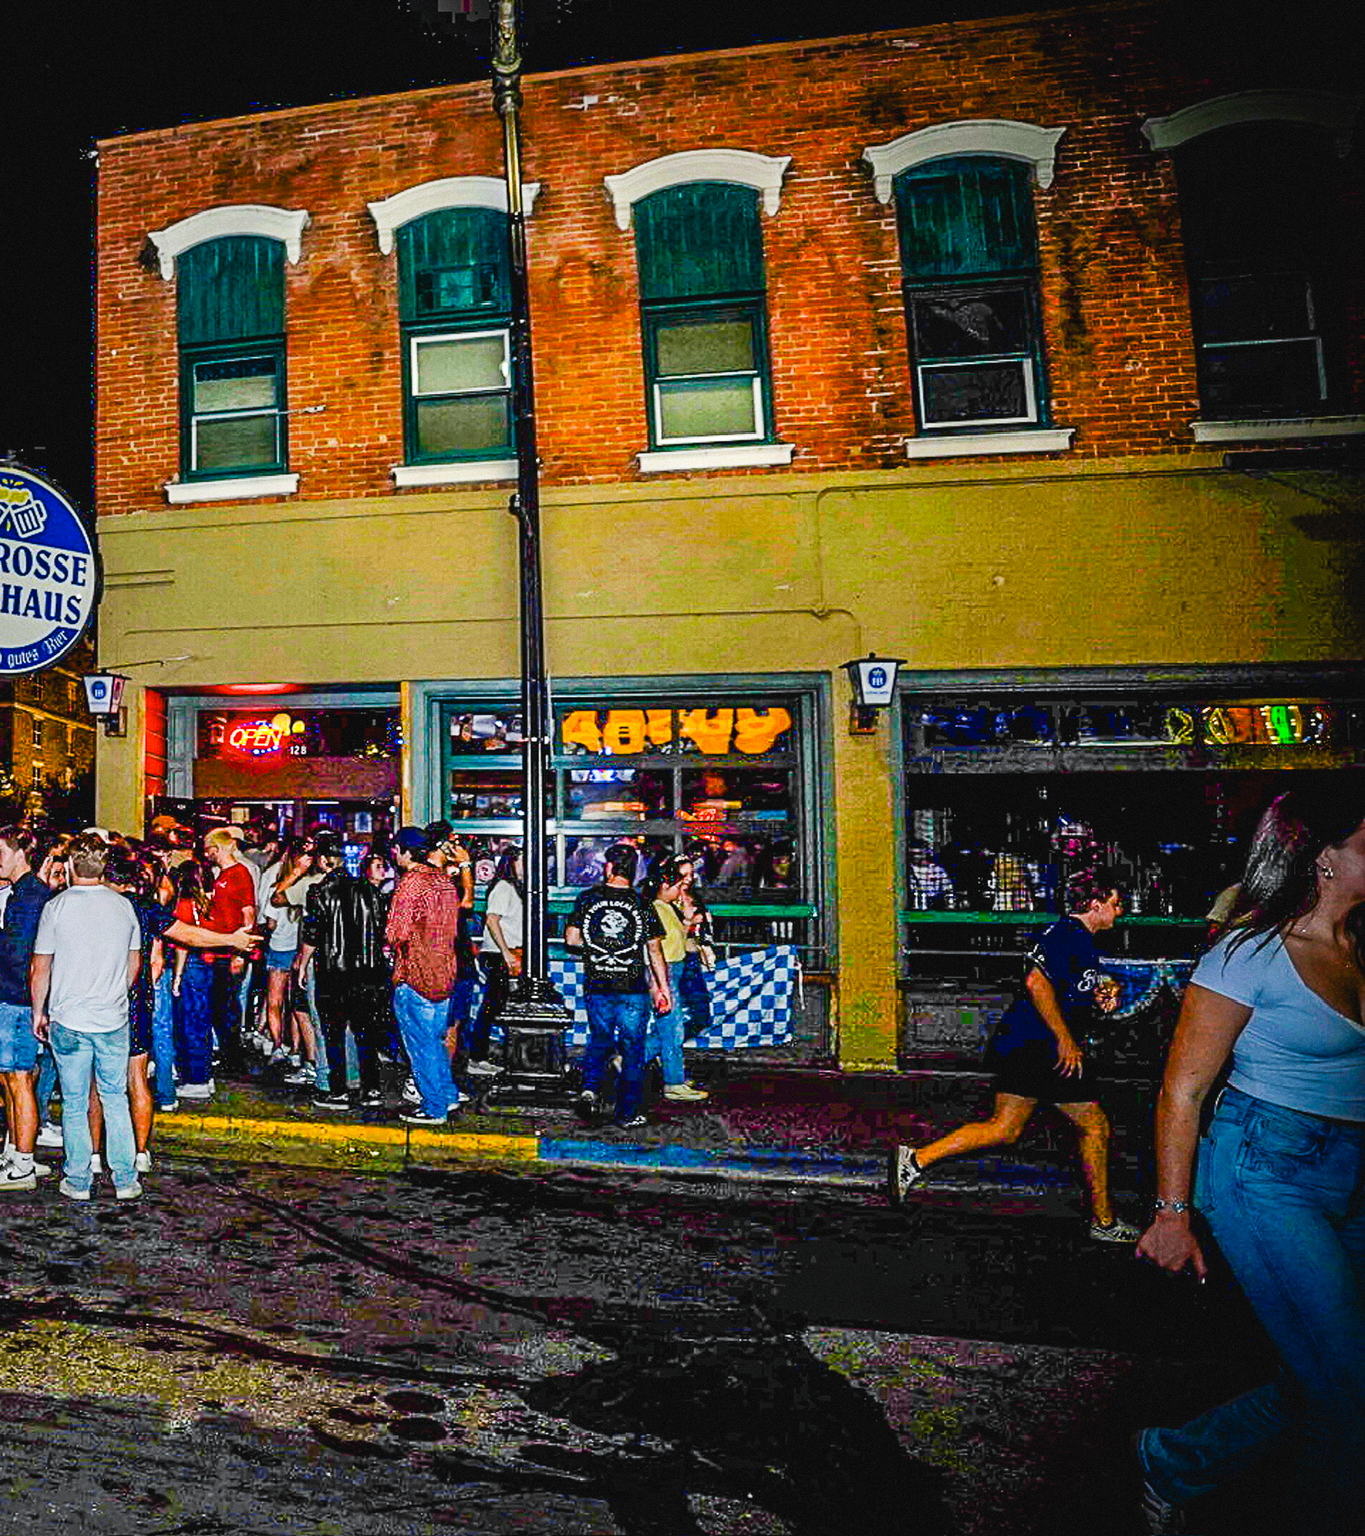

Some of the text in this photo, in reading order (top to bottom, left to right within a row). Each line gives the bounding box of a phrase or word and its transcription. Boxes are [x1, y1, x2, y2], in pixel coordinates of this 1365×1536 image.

[7, 648, 39, 669] gutes
[44, 630, 68, 654] Bier
[229, 728, 282, 747] OPEN
